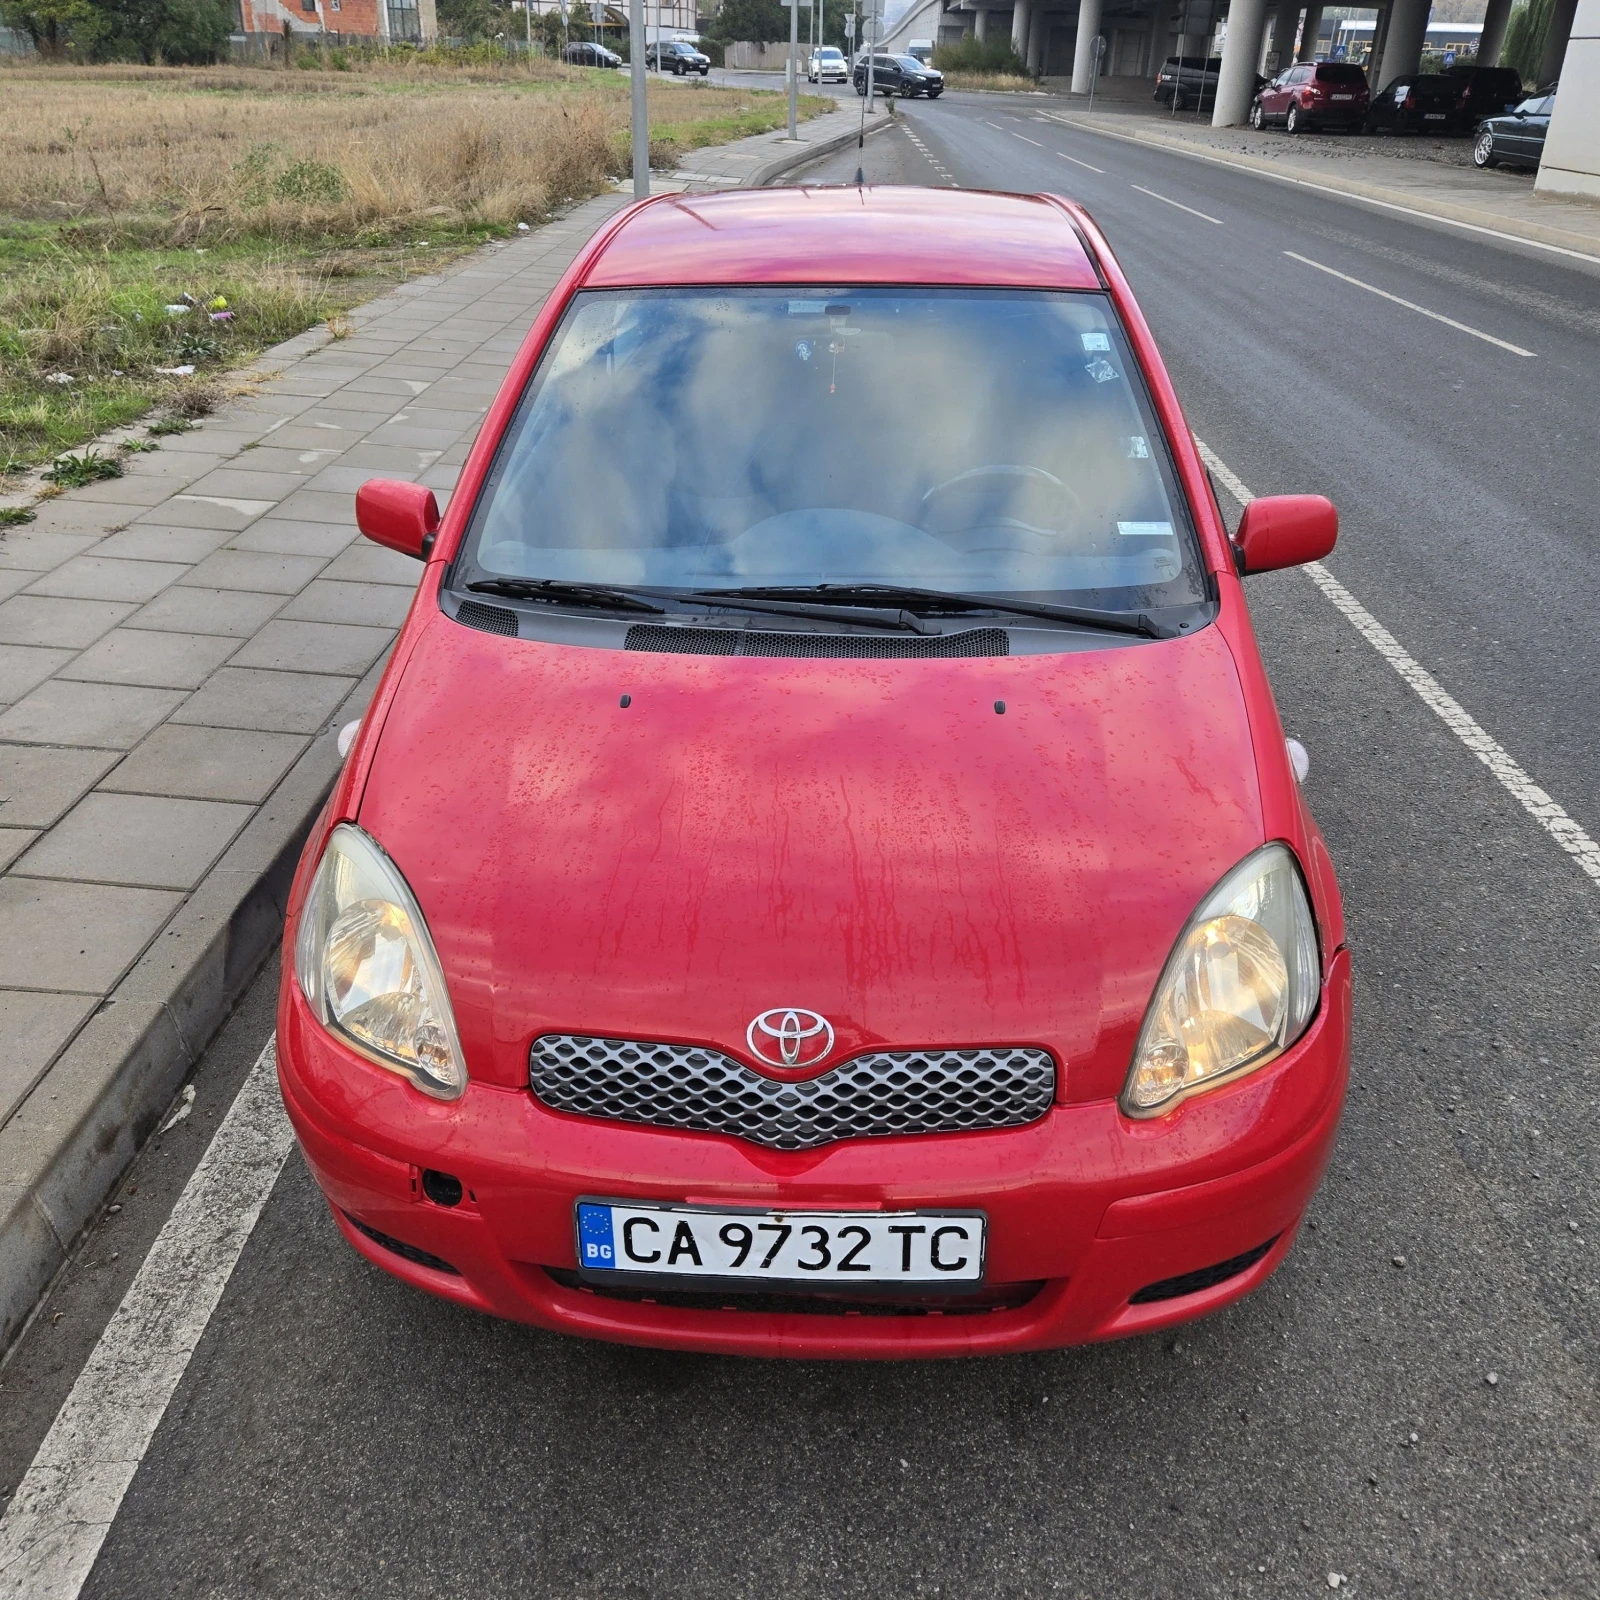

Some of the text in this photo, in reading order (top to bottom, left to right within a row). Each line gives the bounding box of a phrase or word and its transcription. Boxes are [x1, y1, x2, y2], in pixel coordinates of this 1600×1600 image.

[587, 1243, 612, 1259] BG
[623, 1216, 969, 1272] CA 9732 TC
